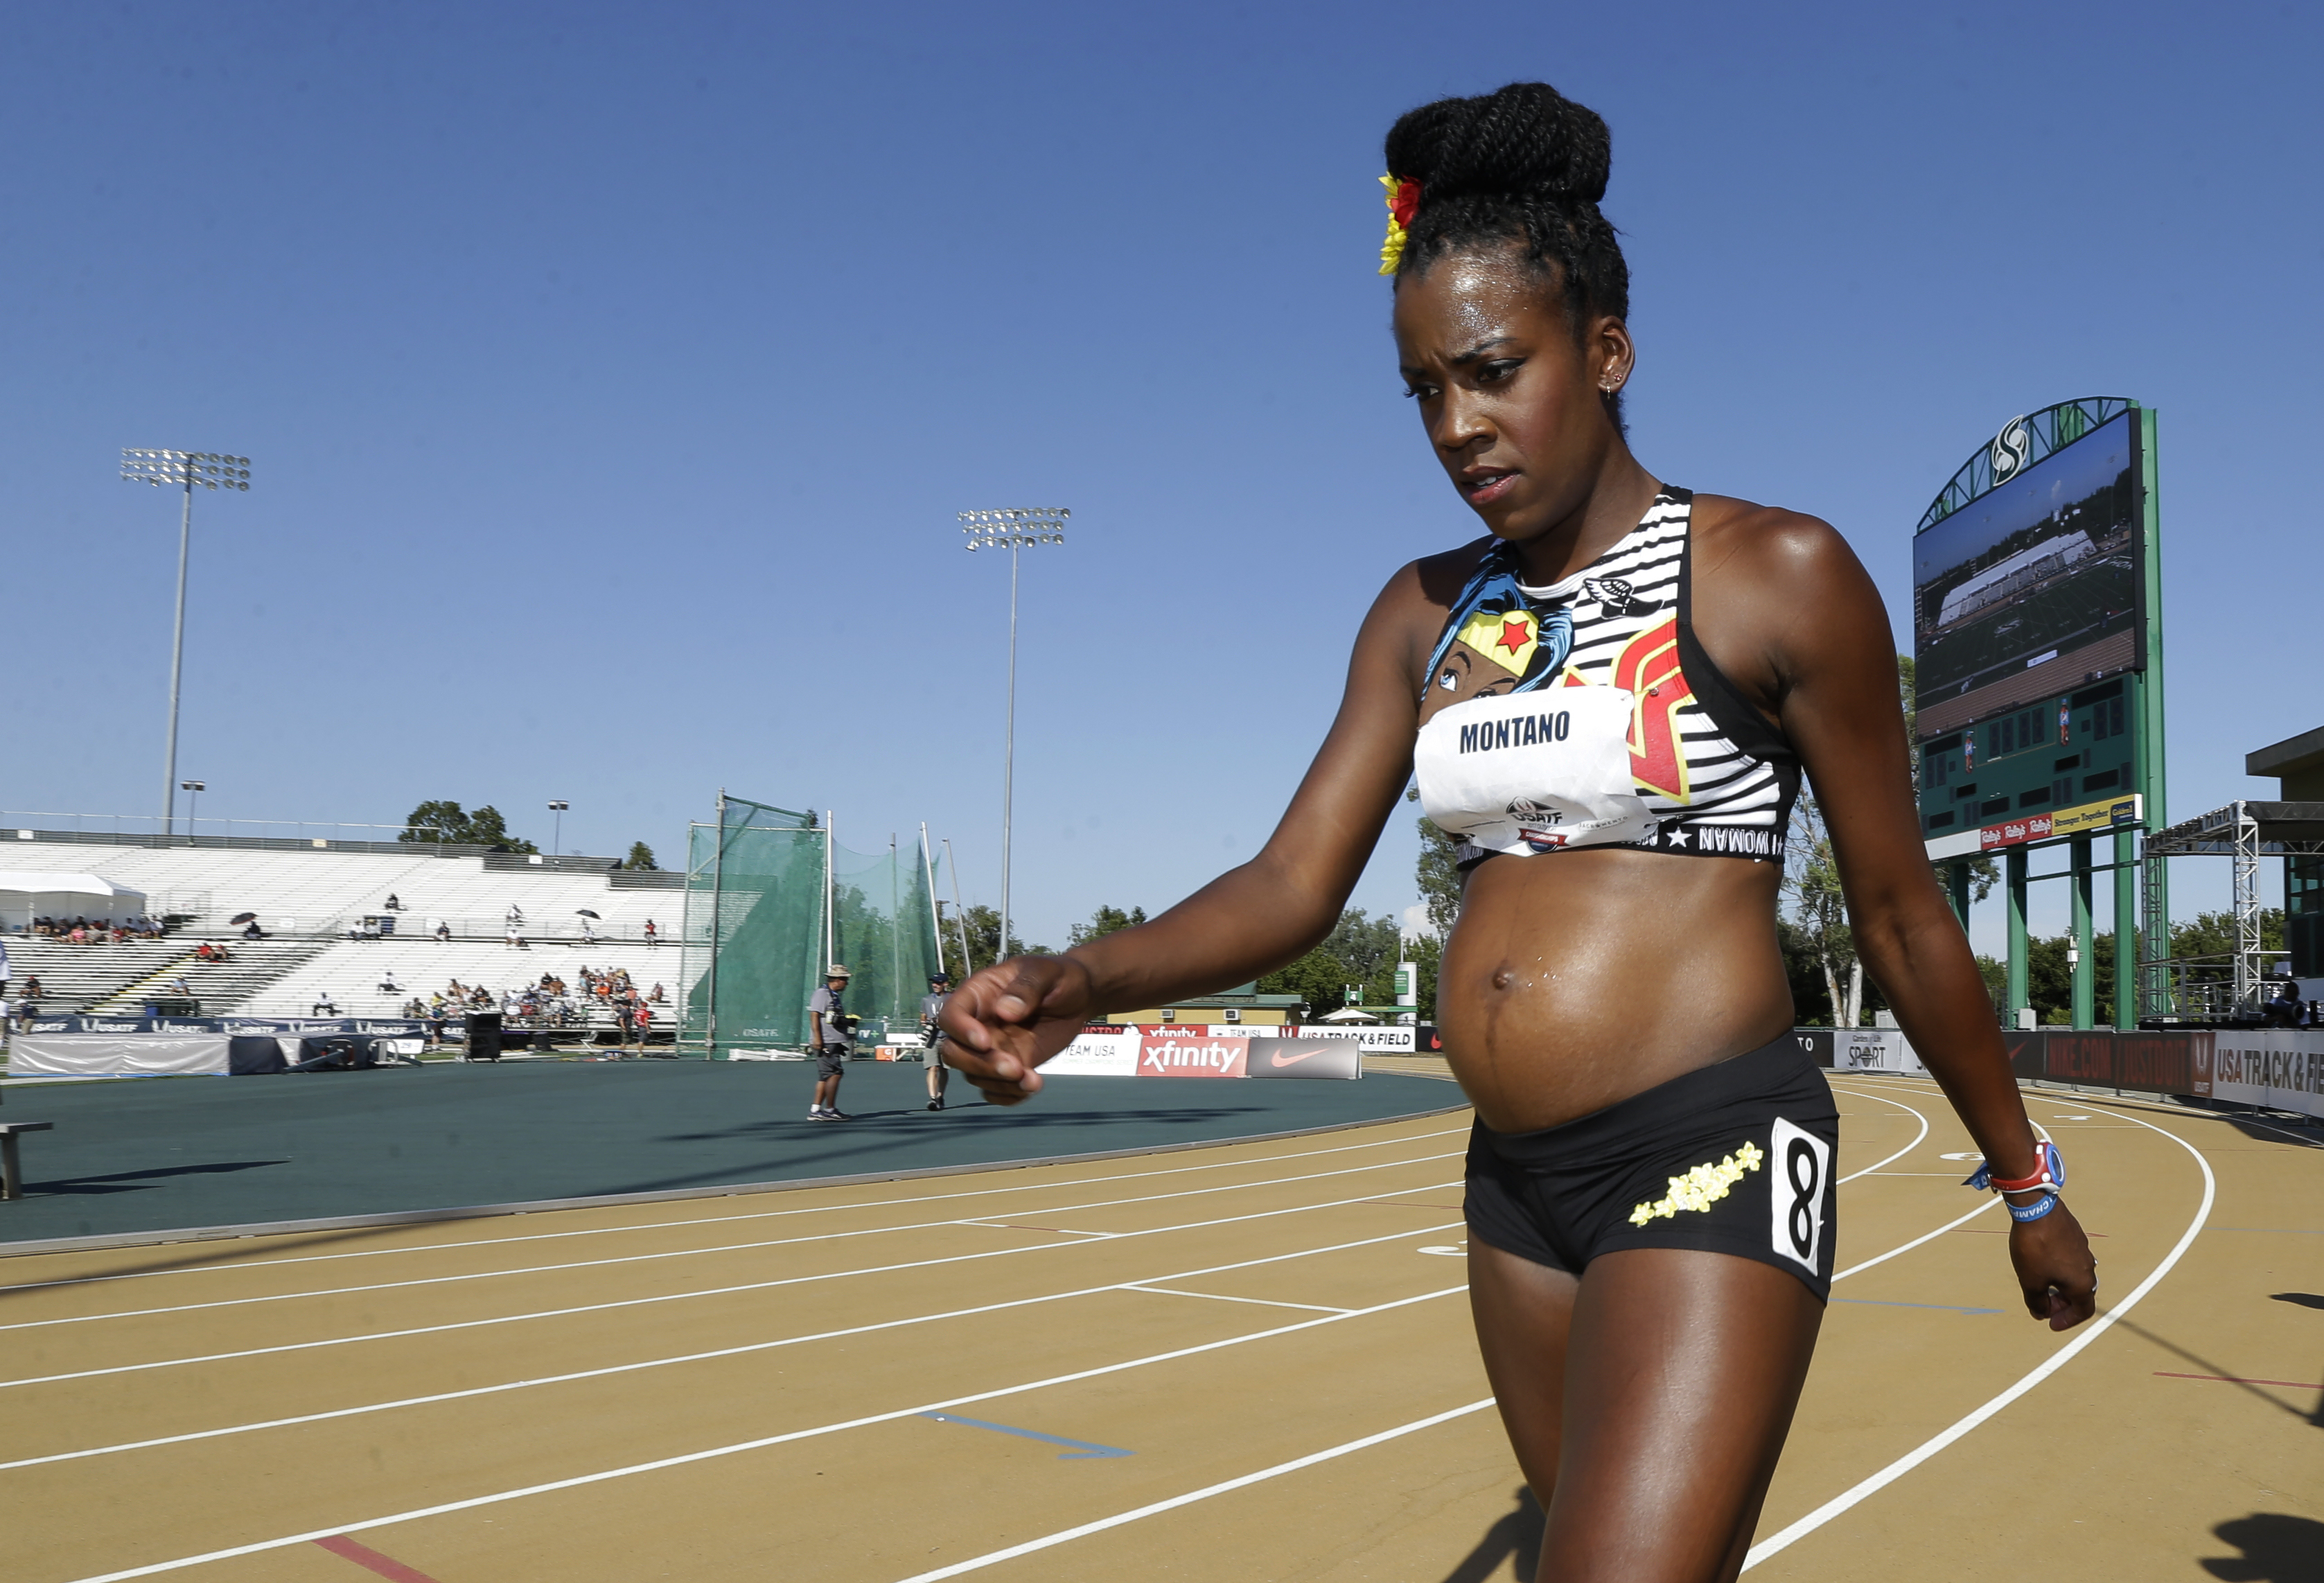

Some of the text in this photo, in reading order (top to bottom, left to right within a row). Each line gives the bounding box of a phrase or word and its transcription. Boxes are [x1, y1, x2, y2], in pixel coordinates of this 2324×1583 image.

[1460, 710, 1570, 754] MONTANO
[1512, 811, 1563, 825] USATF
[1698, 826, 1769, 855] WOMAN
[168, 1025, 209, 1033] USAT
[1150, 1025, 1197, 1038] xfinity
[1329, 1033, 1365, 1045] TRACK
[1368, 1033, 1376, 1045] &
[1377, 1034, 1411, 1045] FIELD
[1094, 1045, 1116, 1056] USA
[1143, 1041, 1241, 1073] xfinity
[1849, 1046, 1886, 1068] SPORT
[2048, 1038, 2112, 1079] NIKE.COM
[2123, 1040, 2187, 1086] JUSTDOIT
[2218, 1048, 2243, 1084] USA
[2244, 1050, 2294, 1090] TRACK
[2294, 1052, 2304, 1092] &
[1786, 1137, 1818, 1261] 8
